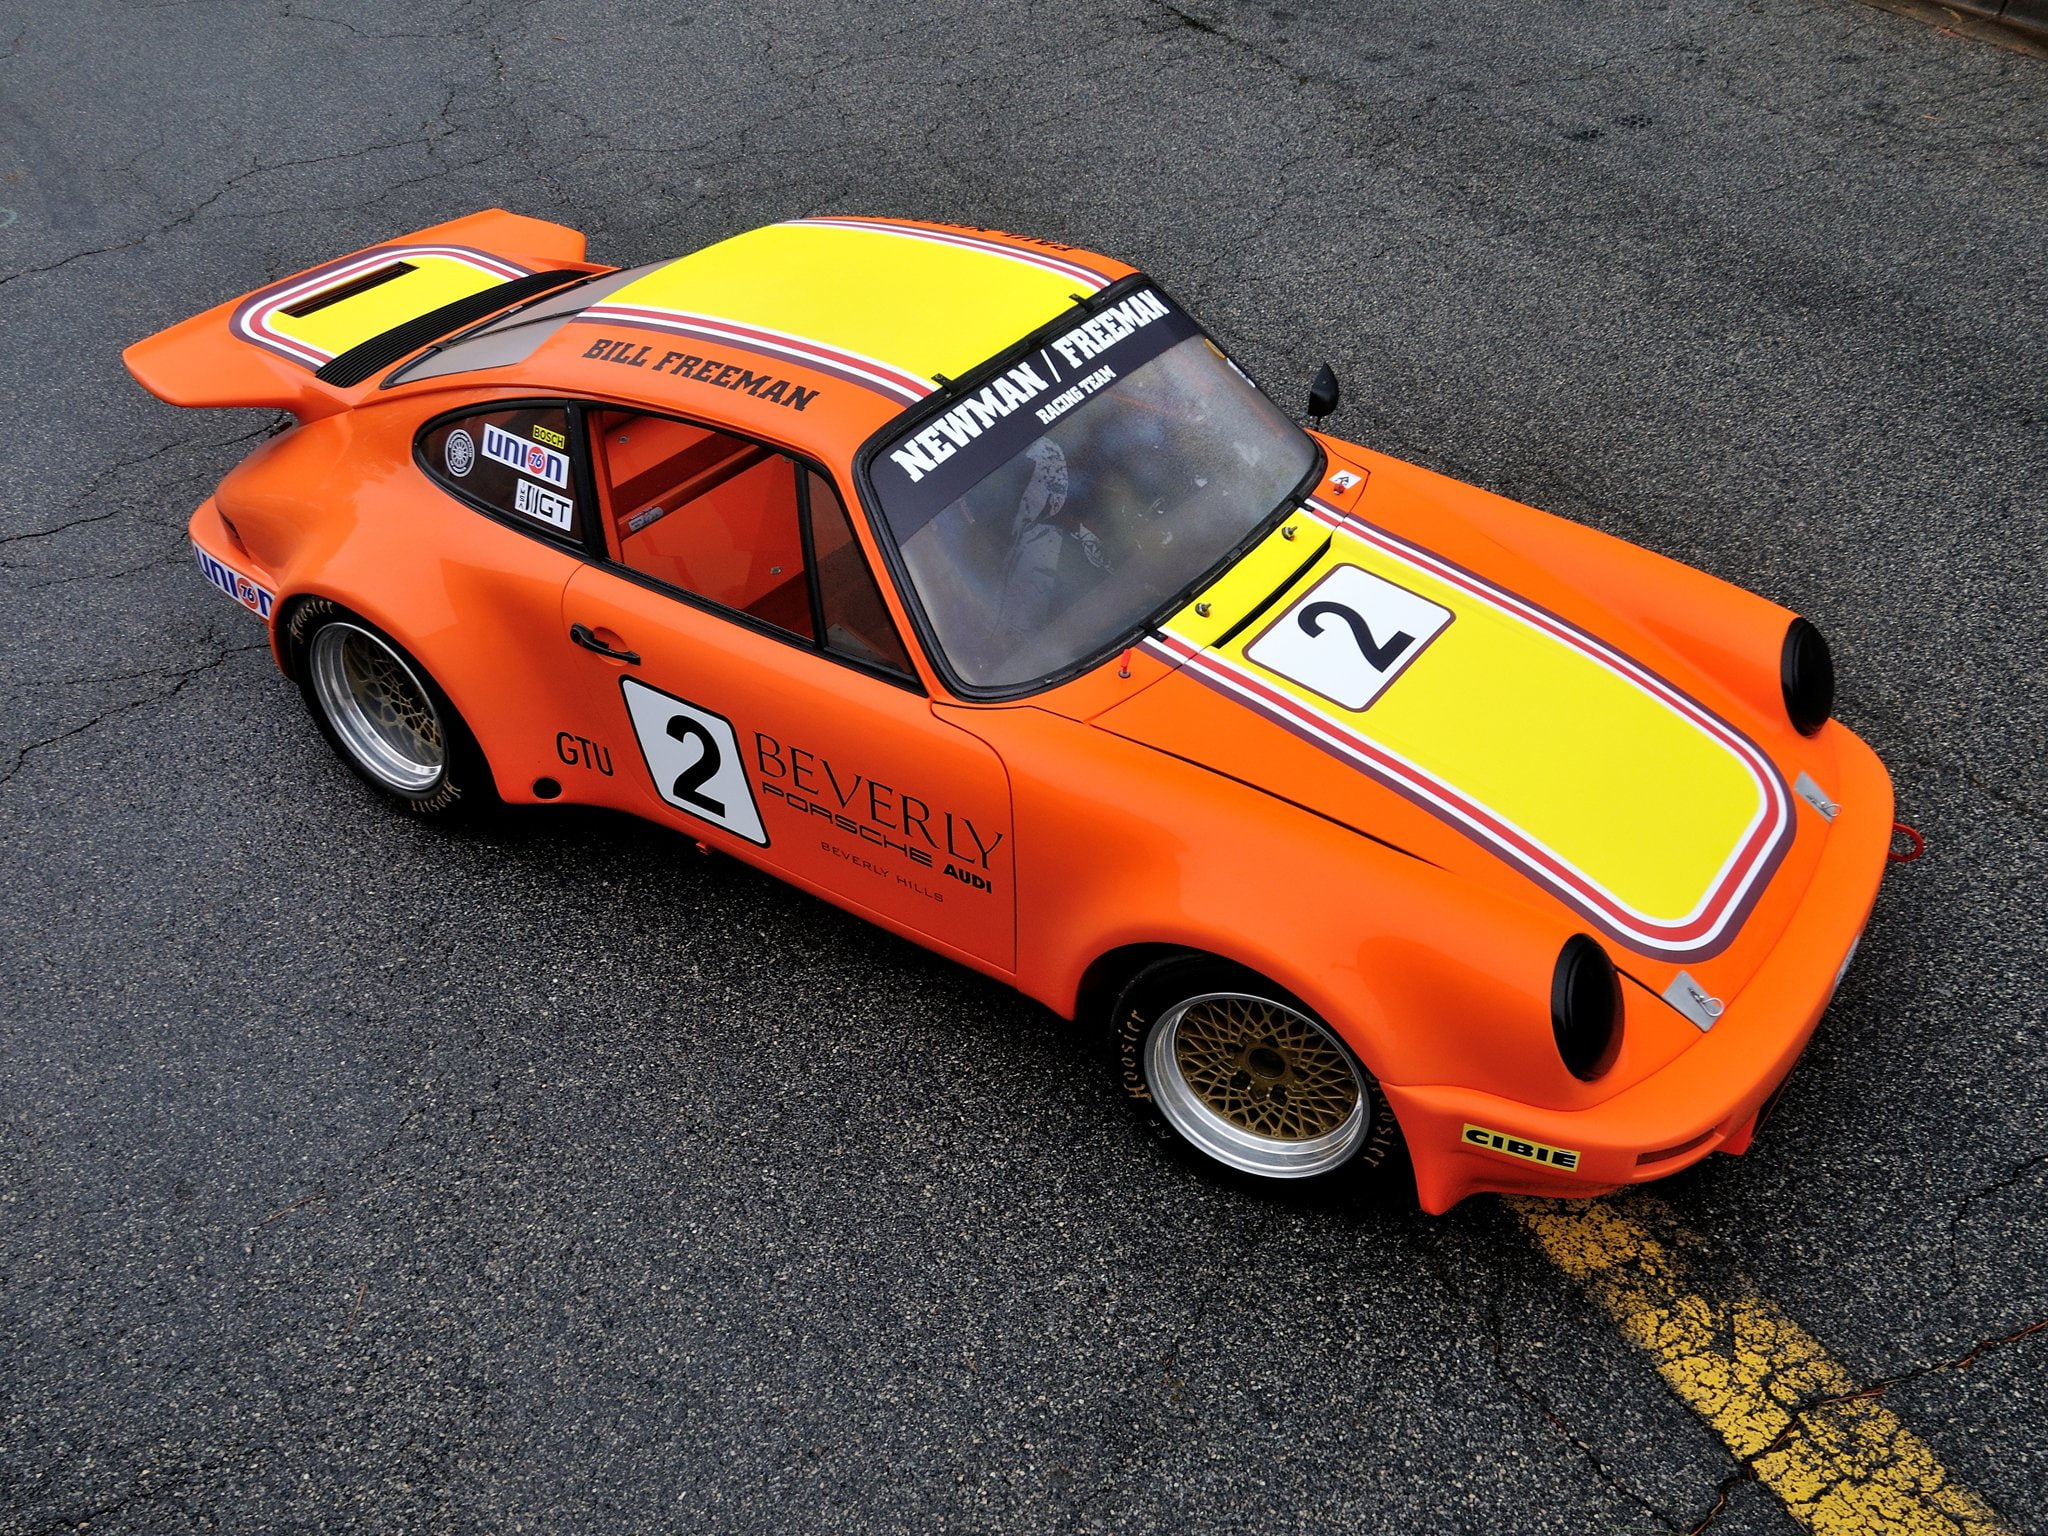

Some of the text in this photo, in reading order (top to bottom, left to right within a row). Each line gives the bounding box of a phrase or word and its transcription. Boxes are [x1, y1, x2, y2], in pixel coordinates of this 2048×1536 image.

[582, 338, 820, 411] BILL FREEMAN
[890, 362, 1049, 483] NEWMAN
[1051, 289, 1170, 369] FREEMAN
[1035, 364, 1117, 425] RACING TEAM
[533, 427, 564, 447] BOSCH
[1298, 601, 1416, 673] 2
[556, 731, 614, 776] GTU
[666, 714, 726, 818] 2
[753, 731, 1003, 871] BEVERLY
[762, 781, 992, 894] PORSCHE AUDI
[821, 842, 944, 903] BEVERLY HILLS
